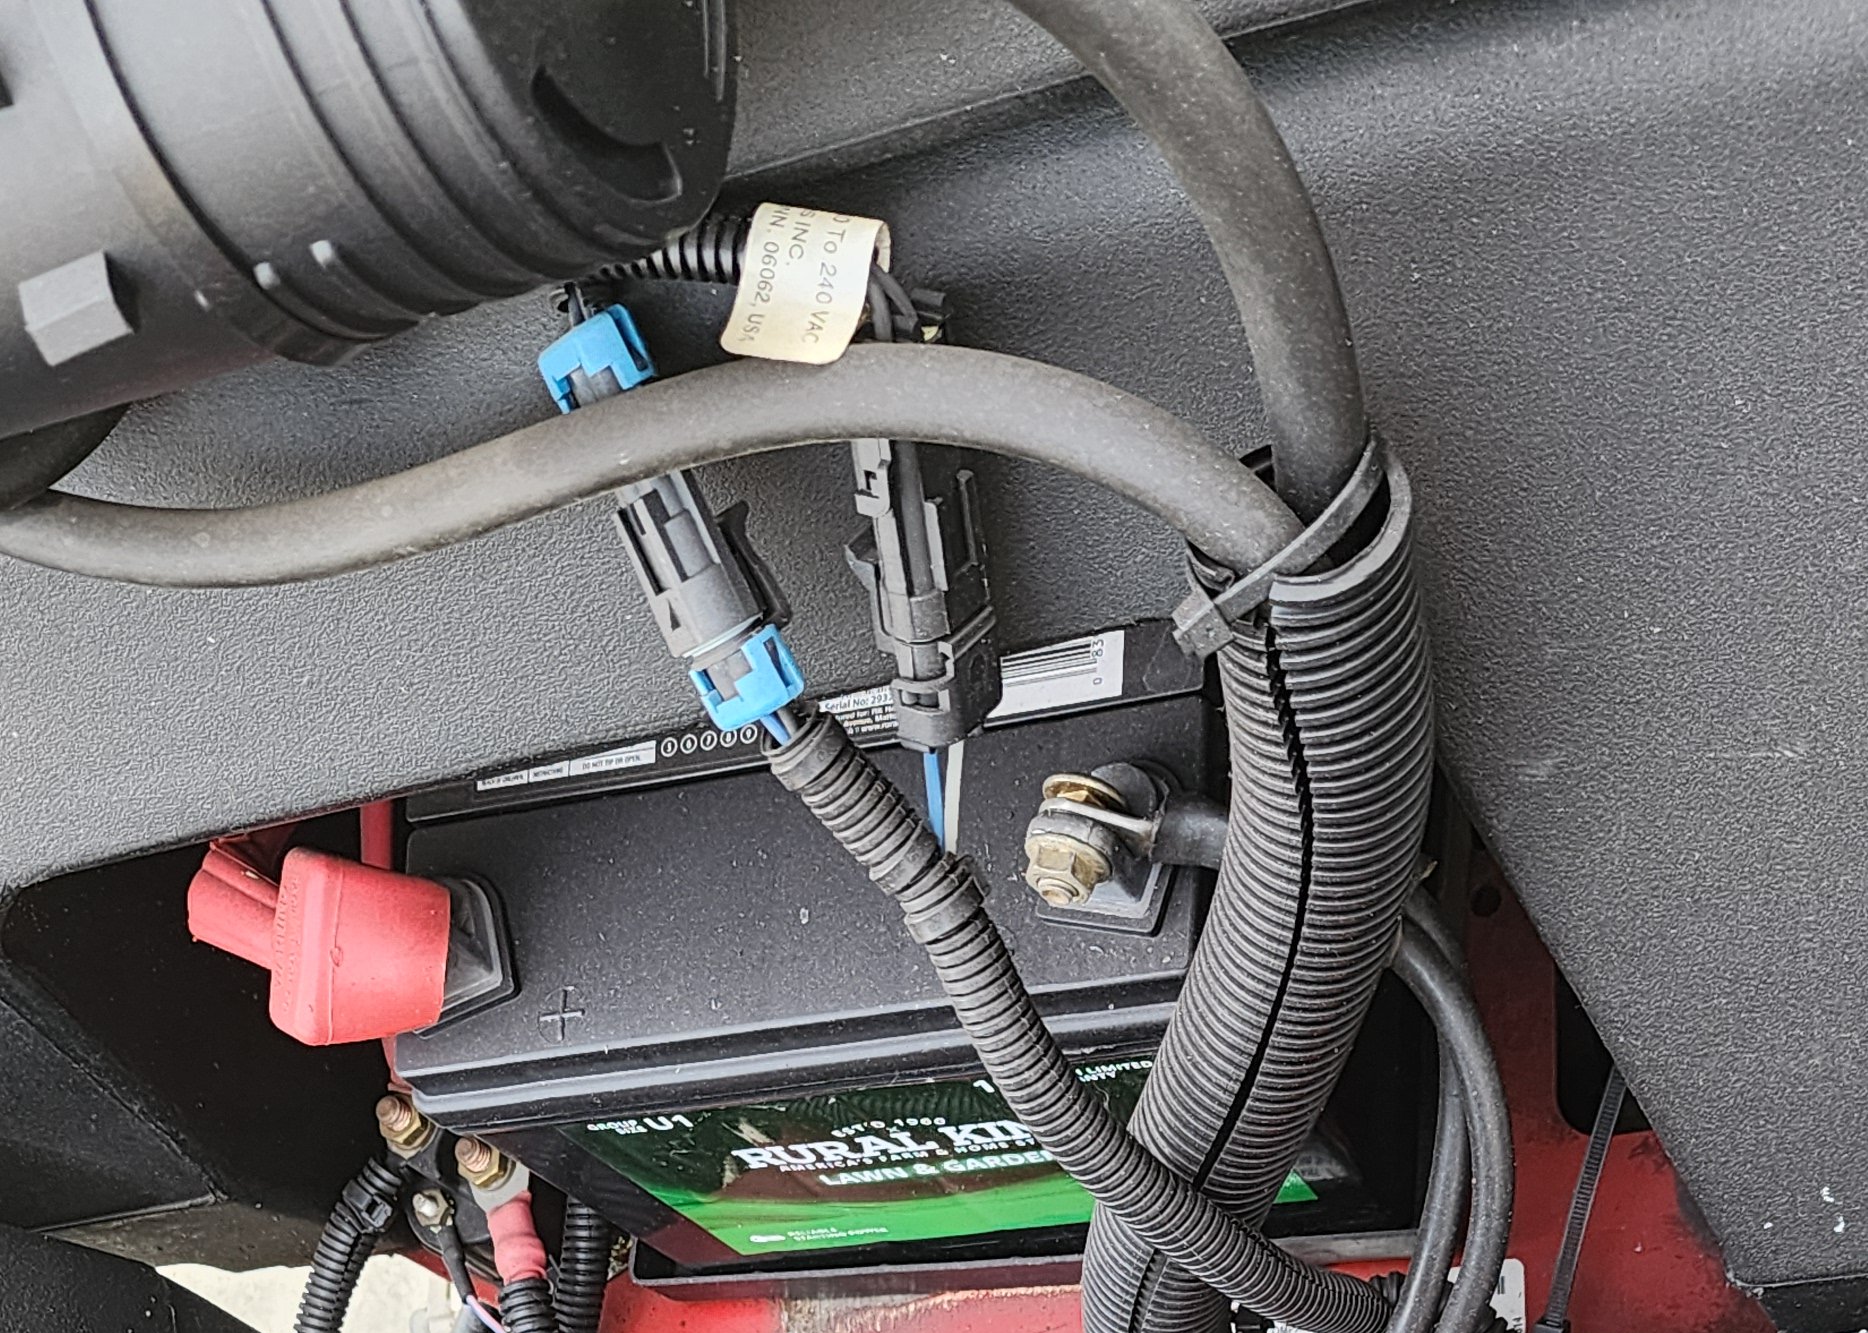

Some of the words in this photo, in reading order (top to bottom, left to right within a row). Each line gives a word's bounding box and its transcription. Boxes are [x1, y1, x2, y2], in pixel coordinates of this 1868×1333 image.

[786, 222, 812, 267] INC.
[815, 261, 838, 305] 240
[739, 312, 766, 342] USA
[802, 309, 827, 344] VAC
[1086, 1061, 1153, 1074] LIMITED
[973, 1079, 995, 1094] 1
[587, 1120, 639, 1131] GROUP
[643, 1114, 693, 1131] U1
[618, 1125, 648, 1135] SIZE
[731, 1131, 940, 1169] RURAL
[937, 1120, 1032, 1148] KIN
[780, 1157, 873, 1173] AMERICA'S
[878, 1150, 929, 1163] FARM
[954, 1142, 1010, 1154] HOME
[819, 1166, 909, 1186] LAWN
[912, 1163, 940, 1175] &
